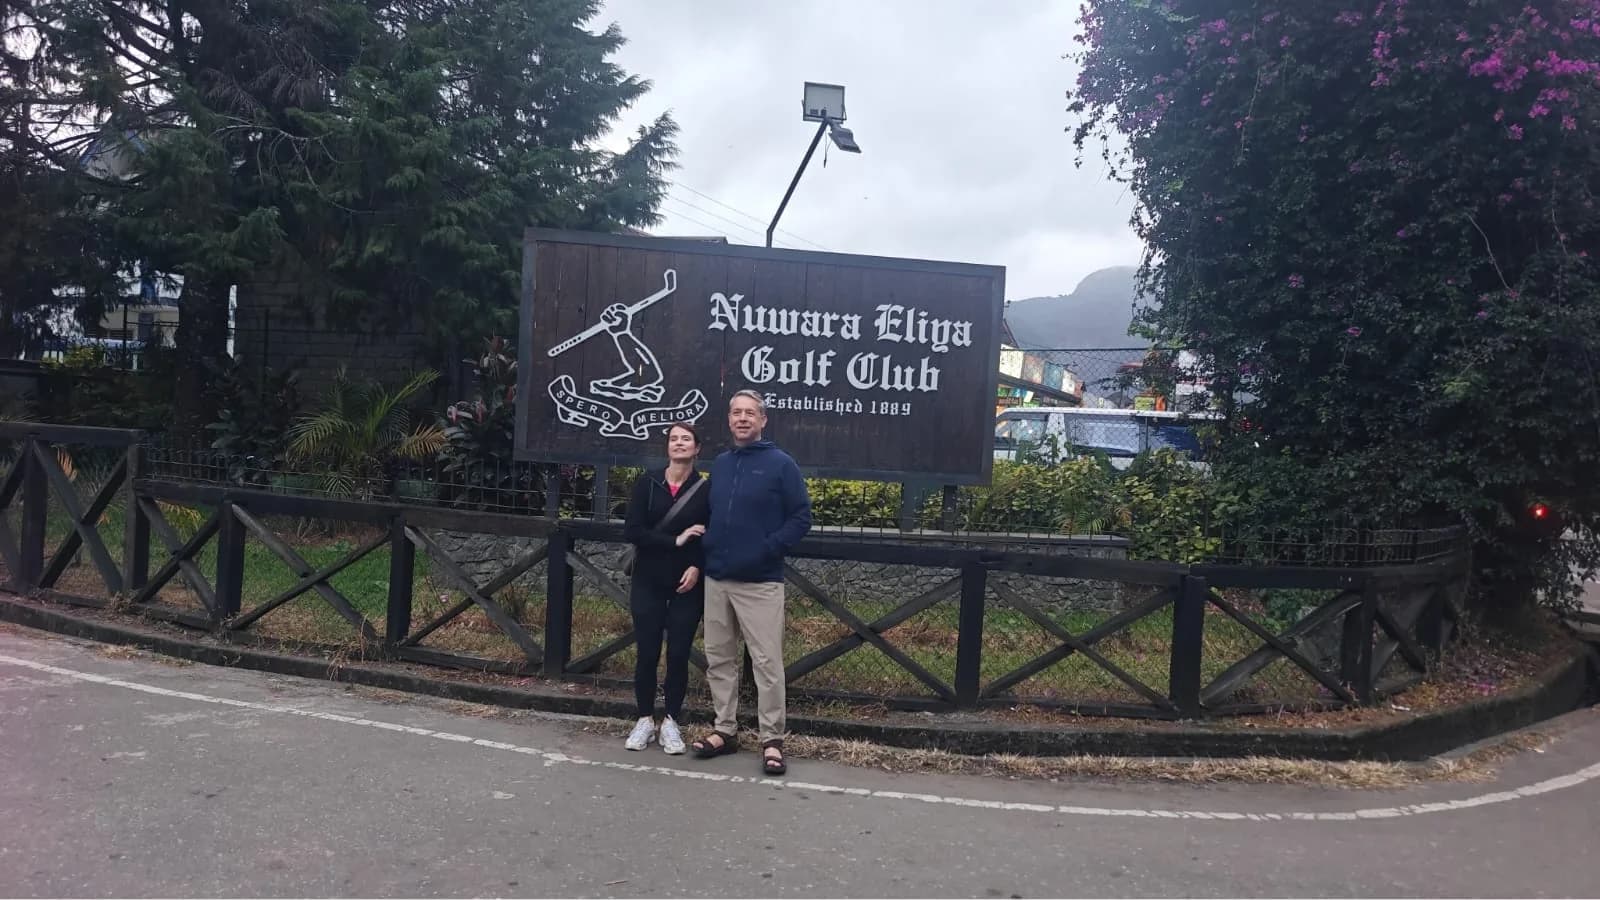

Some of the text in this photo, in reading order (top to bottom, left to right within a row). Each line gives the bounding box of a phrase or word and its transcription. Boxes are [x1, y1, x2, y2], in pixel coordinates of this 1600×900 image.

[708, 292, 973, 353] Nuwara Eliya
[741, 345, 941, 392] Golf Club
[556, 390, 703, 424] SPERO MELIORA
[764, 392, 911, 416] Established 1889
